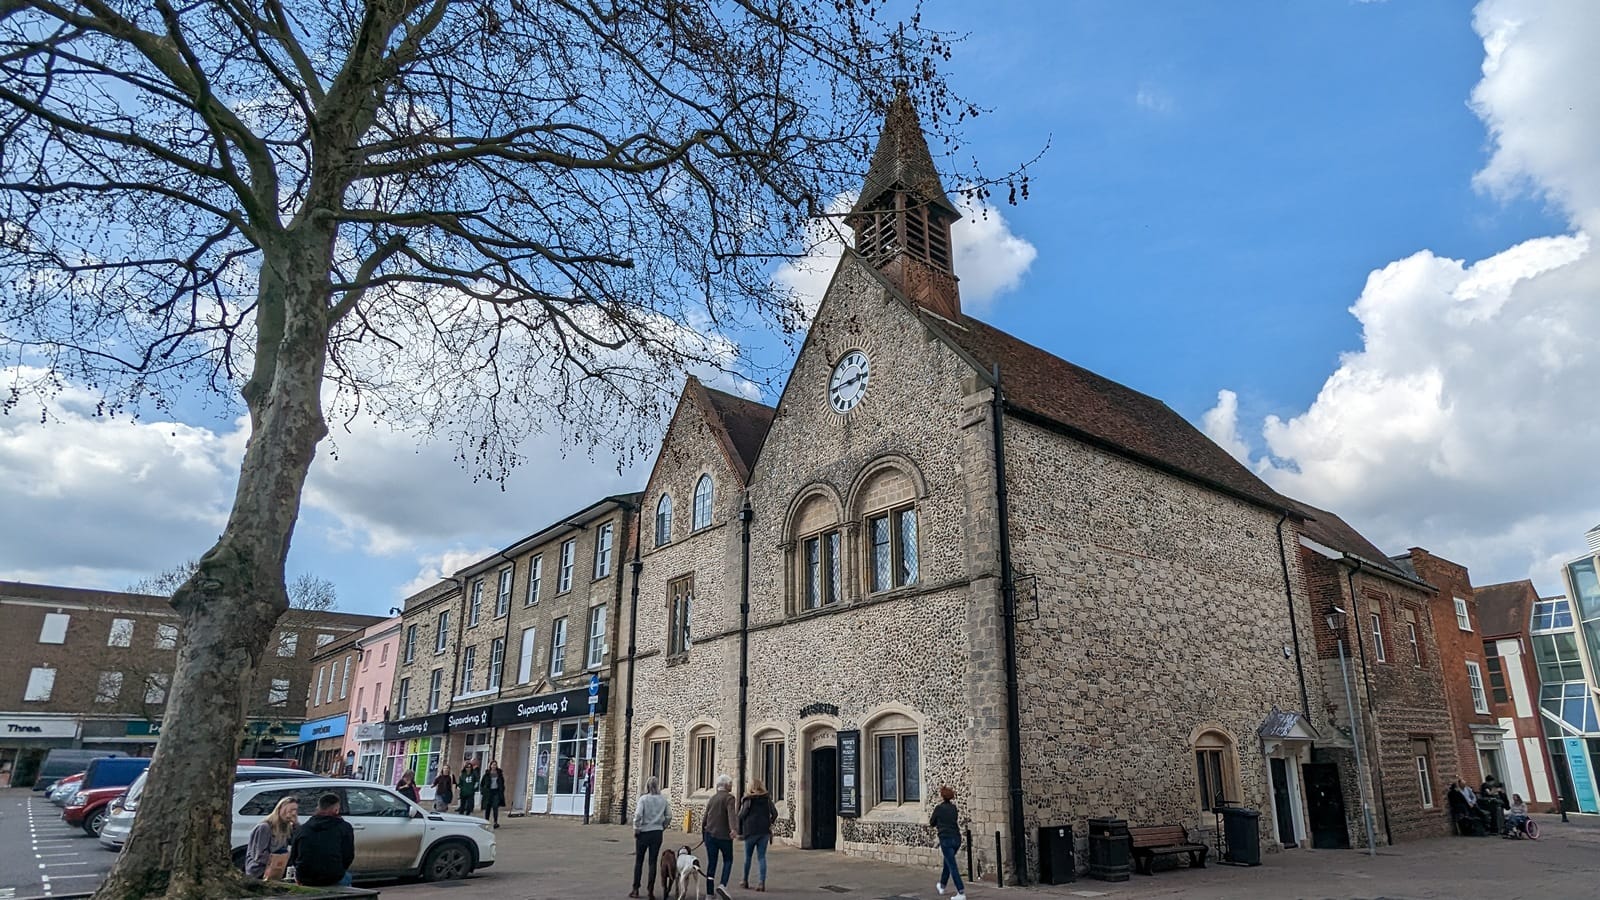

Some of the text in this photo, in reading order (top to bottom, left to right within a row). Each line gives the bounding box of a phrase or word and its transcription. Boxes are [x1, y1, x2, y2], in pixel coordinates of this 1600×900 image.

[517, 700, 559, 718] Superdrug
[799, 703, 839, 719] MUSEUM
[448, 713, 480, 727] Superdrug
